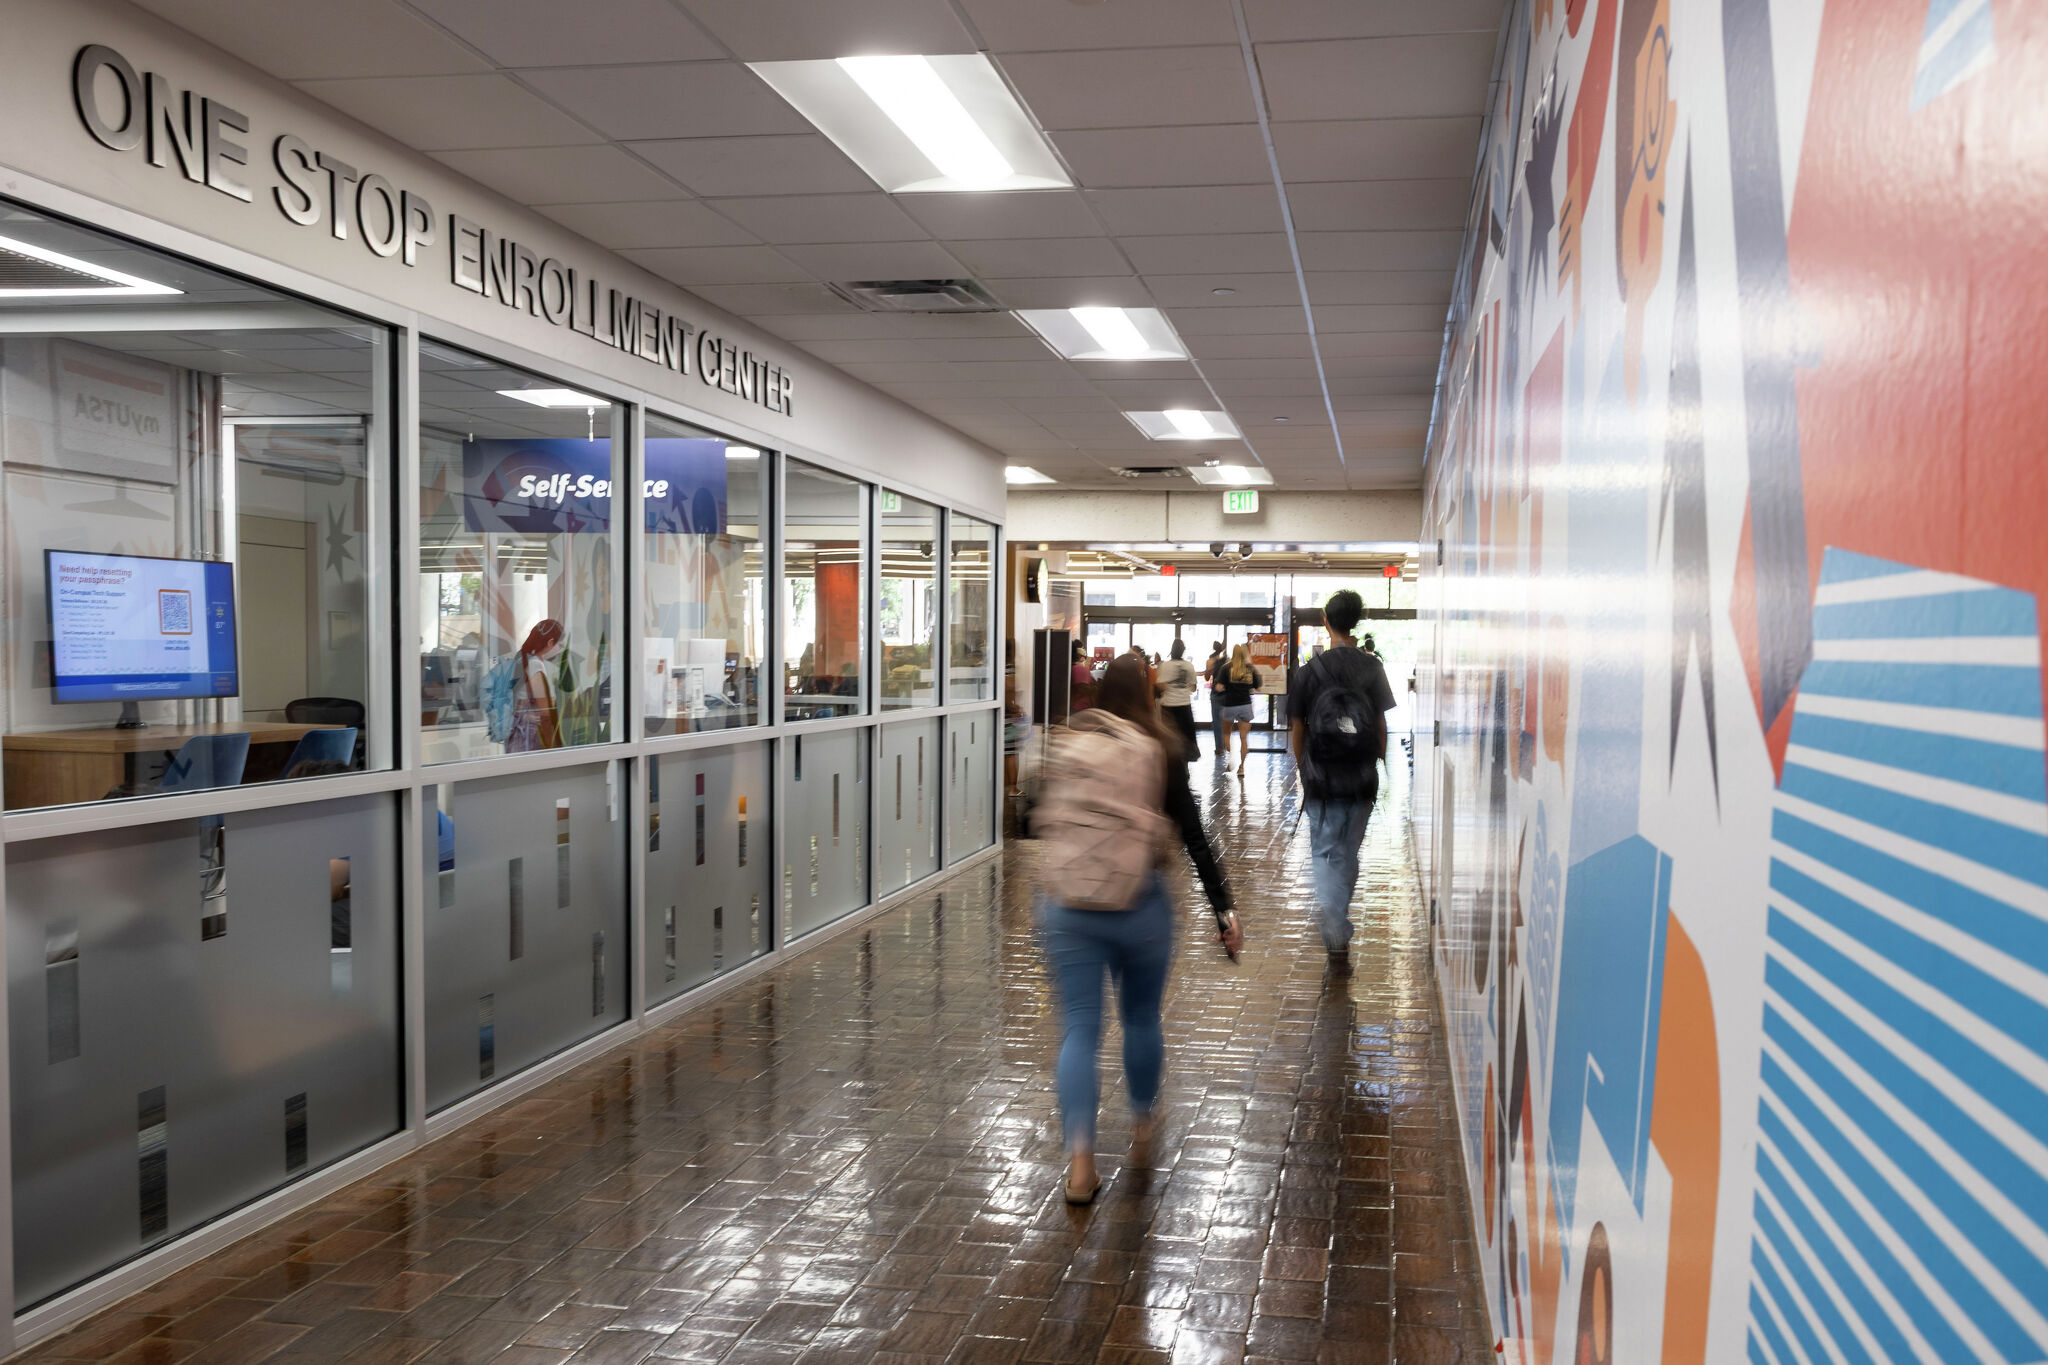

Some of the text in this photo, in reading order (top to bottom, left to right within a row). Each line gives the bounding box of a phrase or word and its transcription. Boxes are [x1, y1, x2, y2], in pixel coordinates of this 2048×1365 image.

[71, 43, 795, 417] ONE STOP ENROLLMENT CENTER
[517, 473, 669, 504] Self-Sece
[1229, 491, 1253, 511] EXIT
[59, 565, 132, 578] Need help resetting
